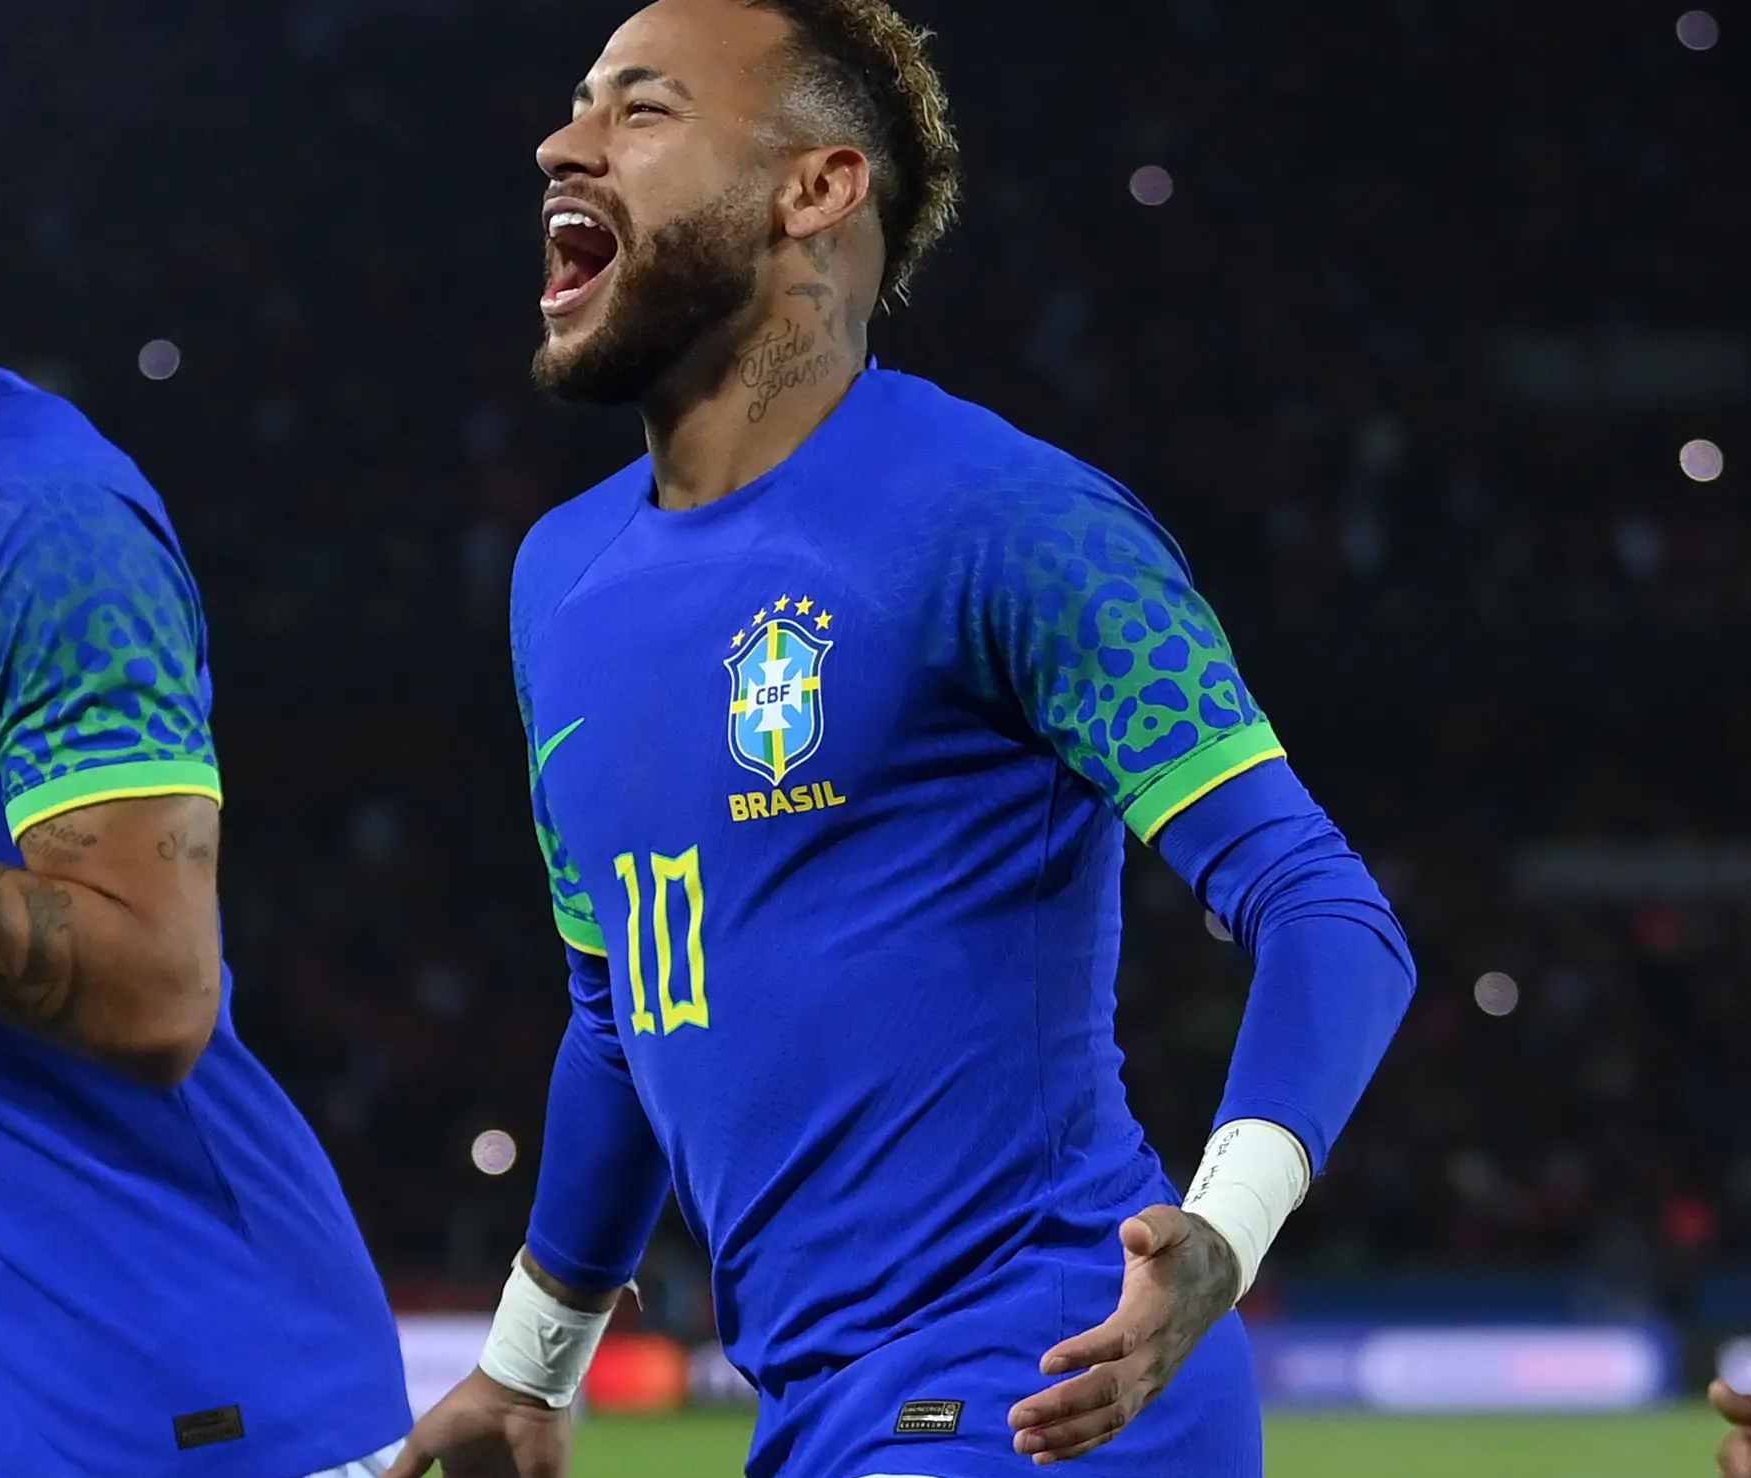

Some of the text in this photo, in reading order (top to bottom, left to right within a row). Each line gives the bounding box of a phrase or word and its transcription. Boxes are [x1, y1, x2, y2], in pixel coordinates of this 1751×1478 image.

[755, 683, 791, 706] CBF
[728, 780, 846, 822] BRASIL
[613, 843, 710, 1037] 10
